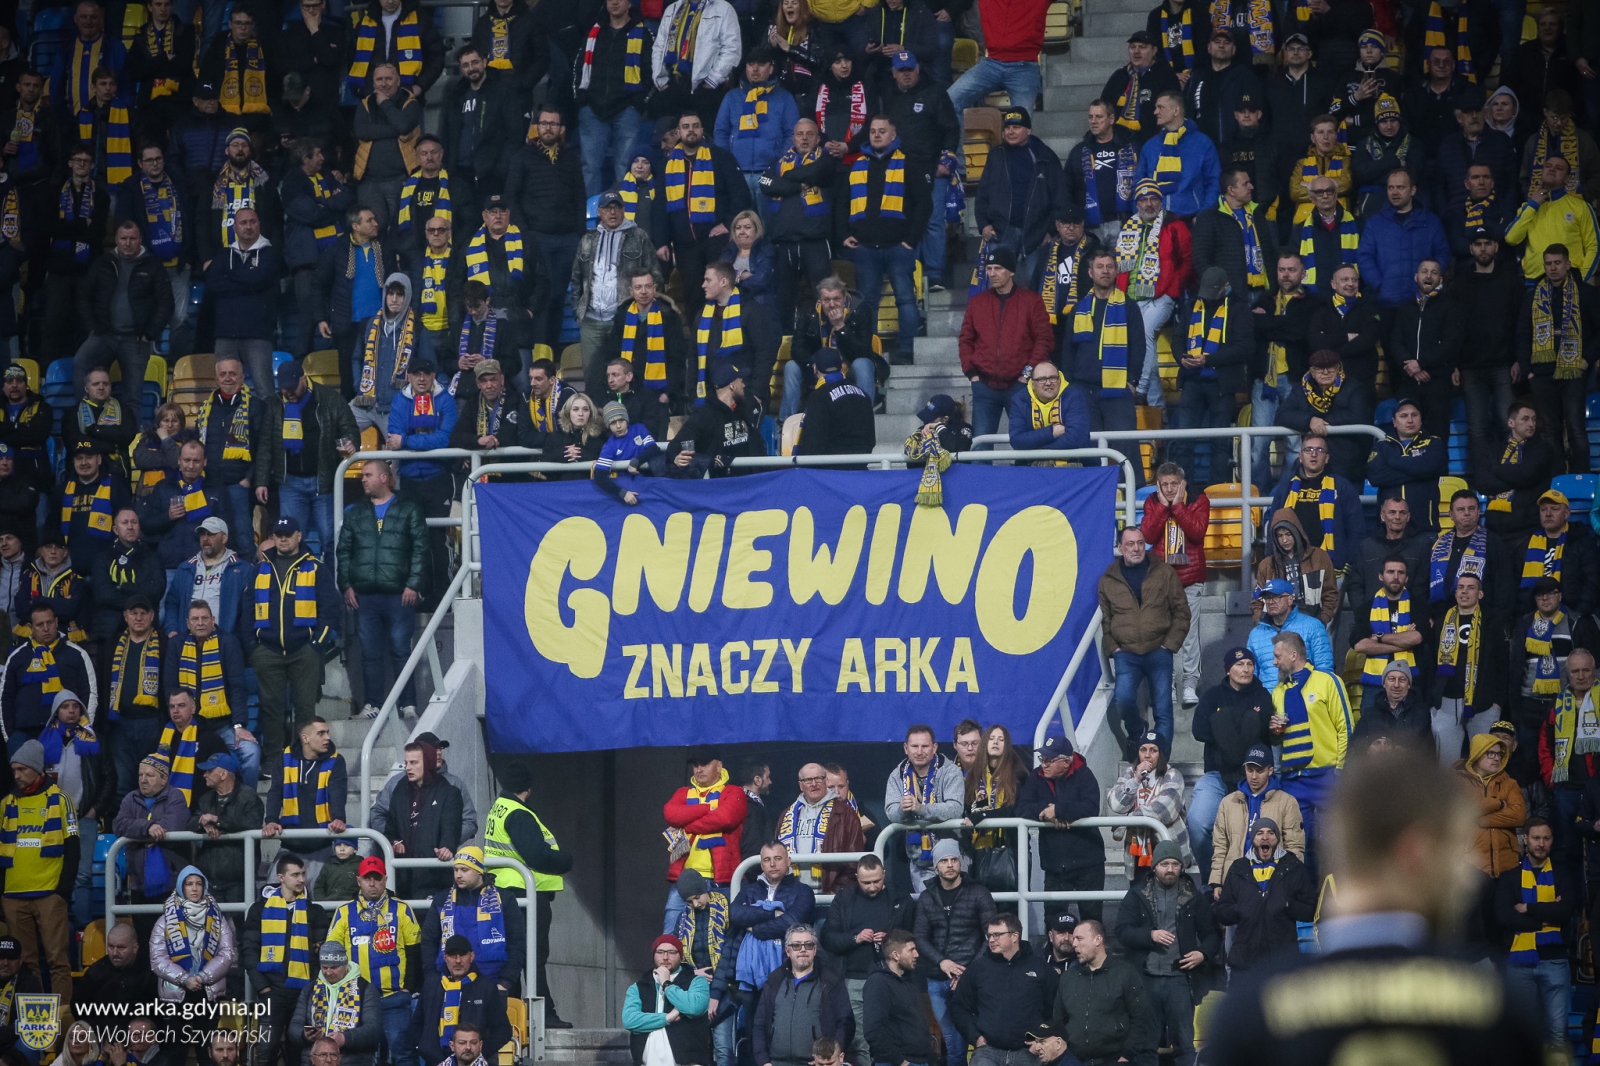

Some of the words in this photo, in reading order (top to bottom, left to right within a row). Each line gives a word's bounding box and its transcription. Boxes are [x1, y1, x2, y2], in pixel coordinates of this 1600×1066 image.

[1378, 112, 1400, 121] ARKA
[525, 503, 1078, 679] GNIEWINO
[622, 638, 812, 699] ZNACZY
[836, 637, 979, 694] ARKA
[334, 1020, 352, 1029] ARKA
